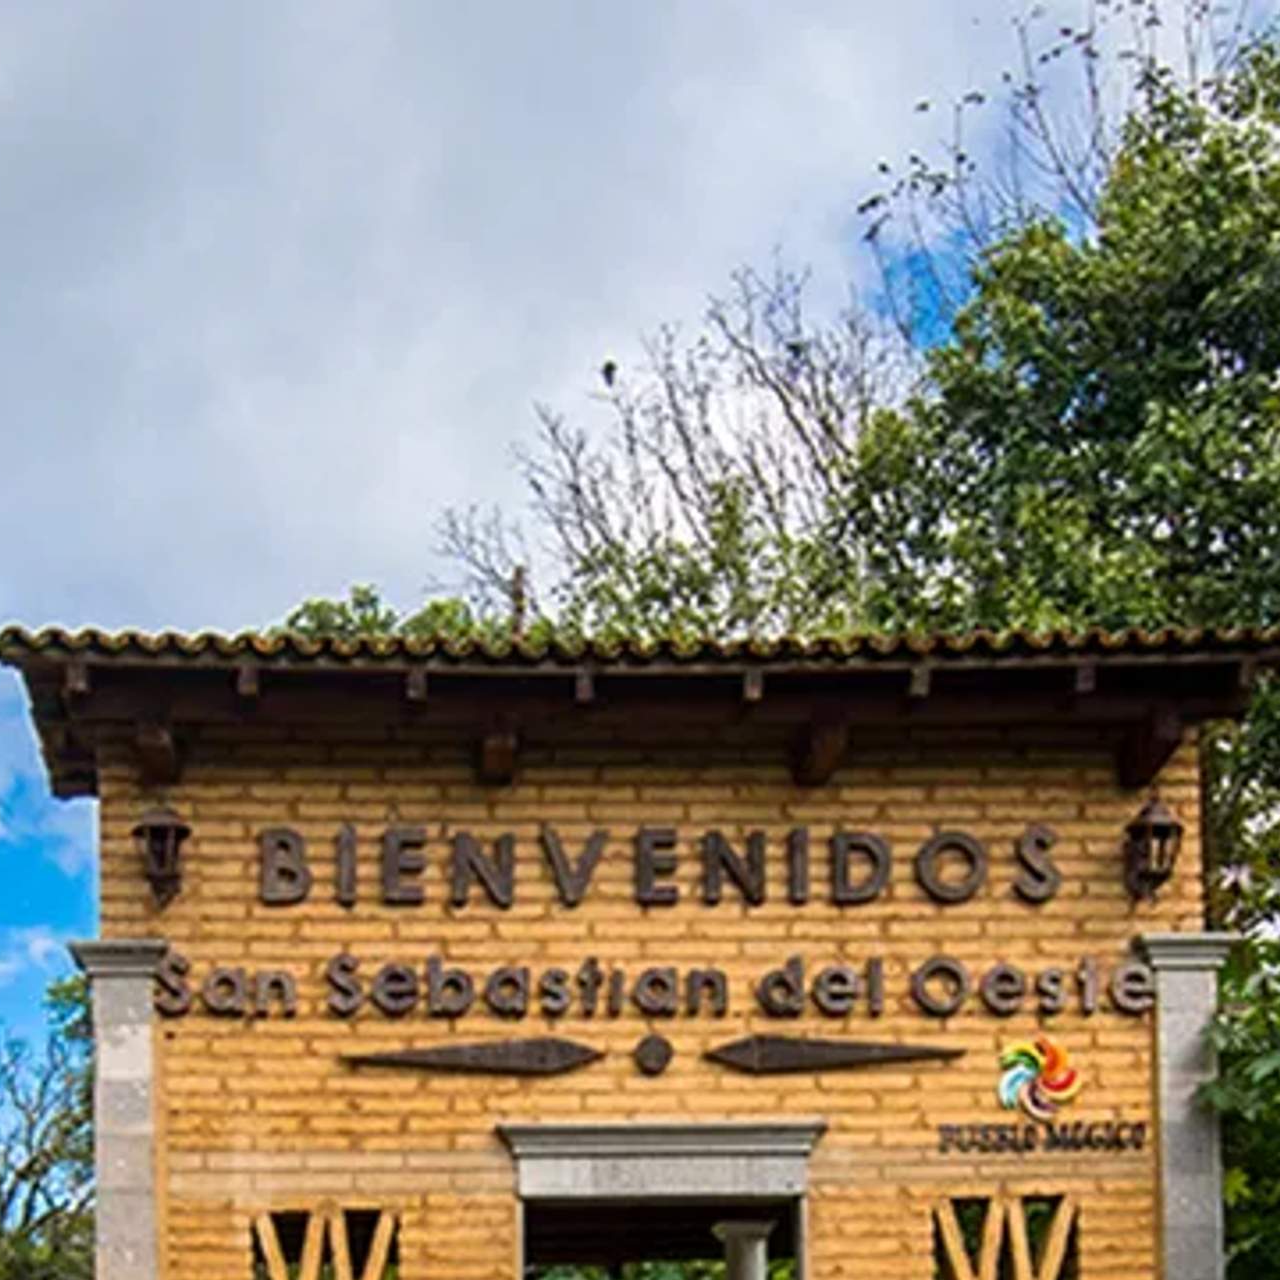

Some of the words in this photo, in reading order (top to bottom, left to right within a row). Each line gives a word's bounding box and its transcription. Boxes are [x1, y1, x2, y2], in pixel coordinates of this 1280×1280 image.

[256, 822, 1064, 908] BIENVENIDOS
[154, 951, 297, 1018] San
[325, 951, 728, 1019] Sebastian
[754, 953, 883, 1019] del
[912, 954, 1156, 1018] Oeste
